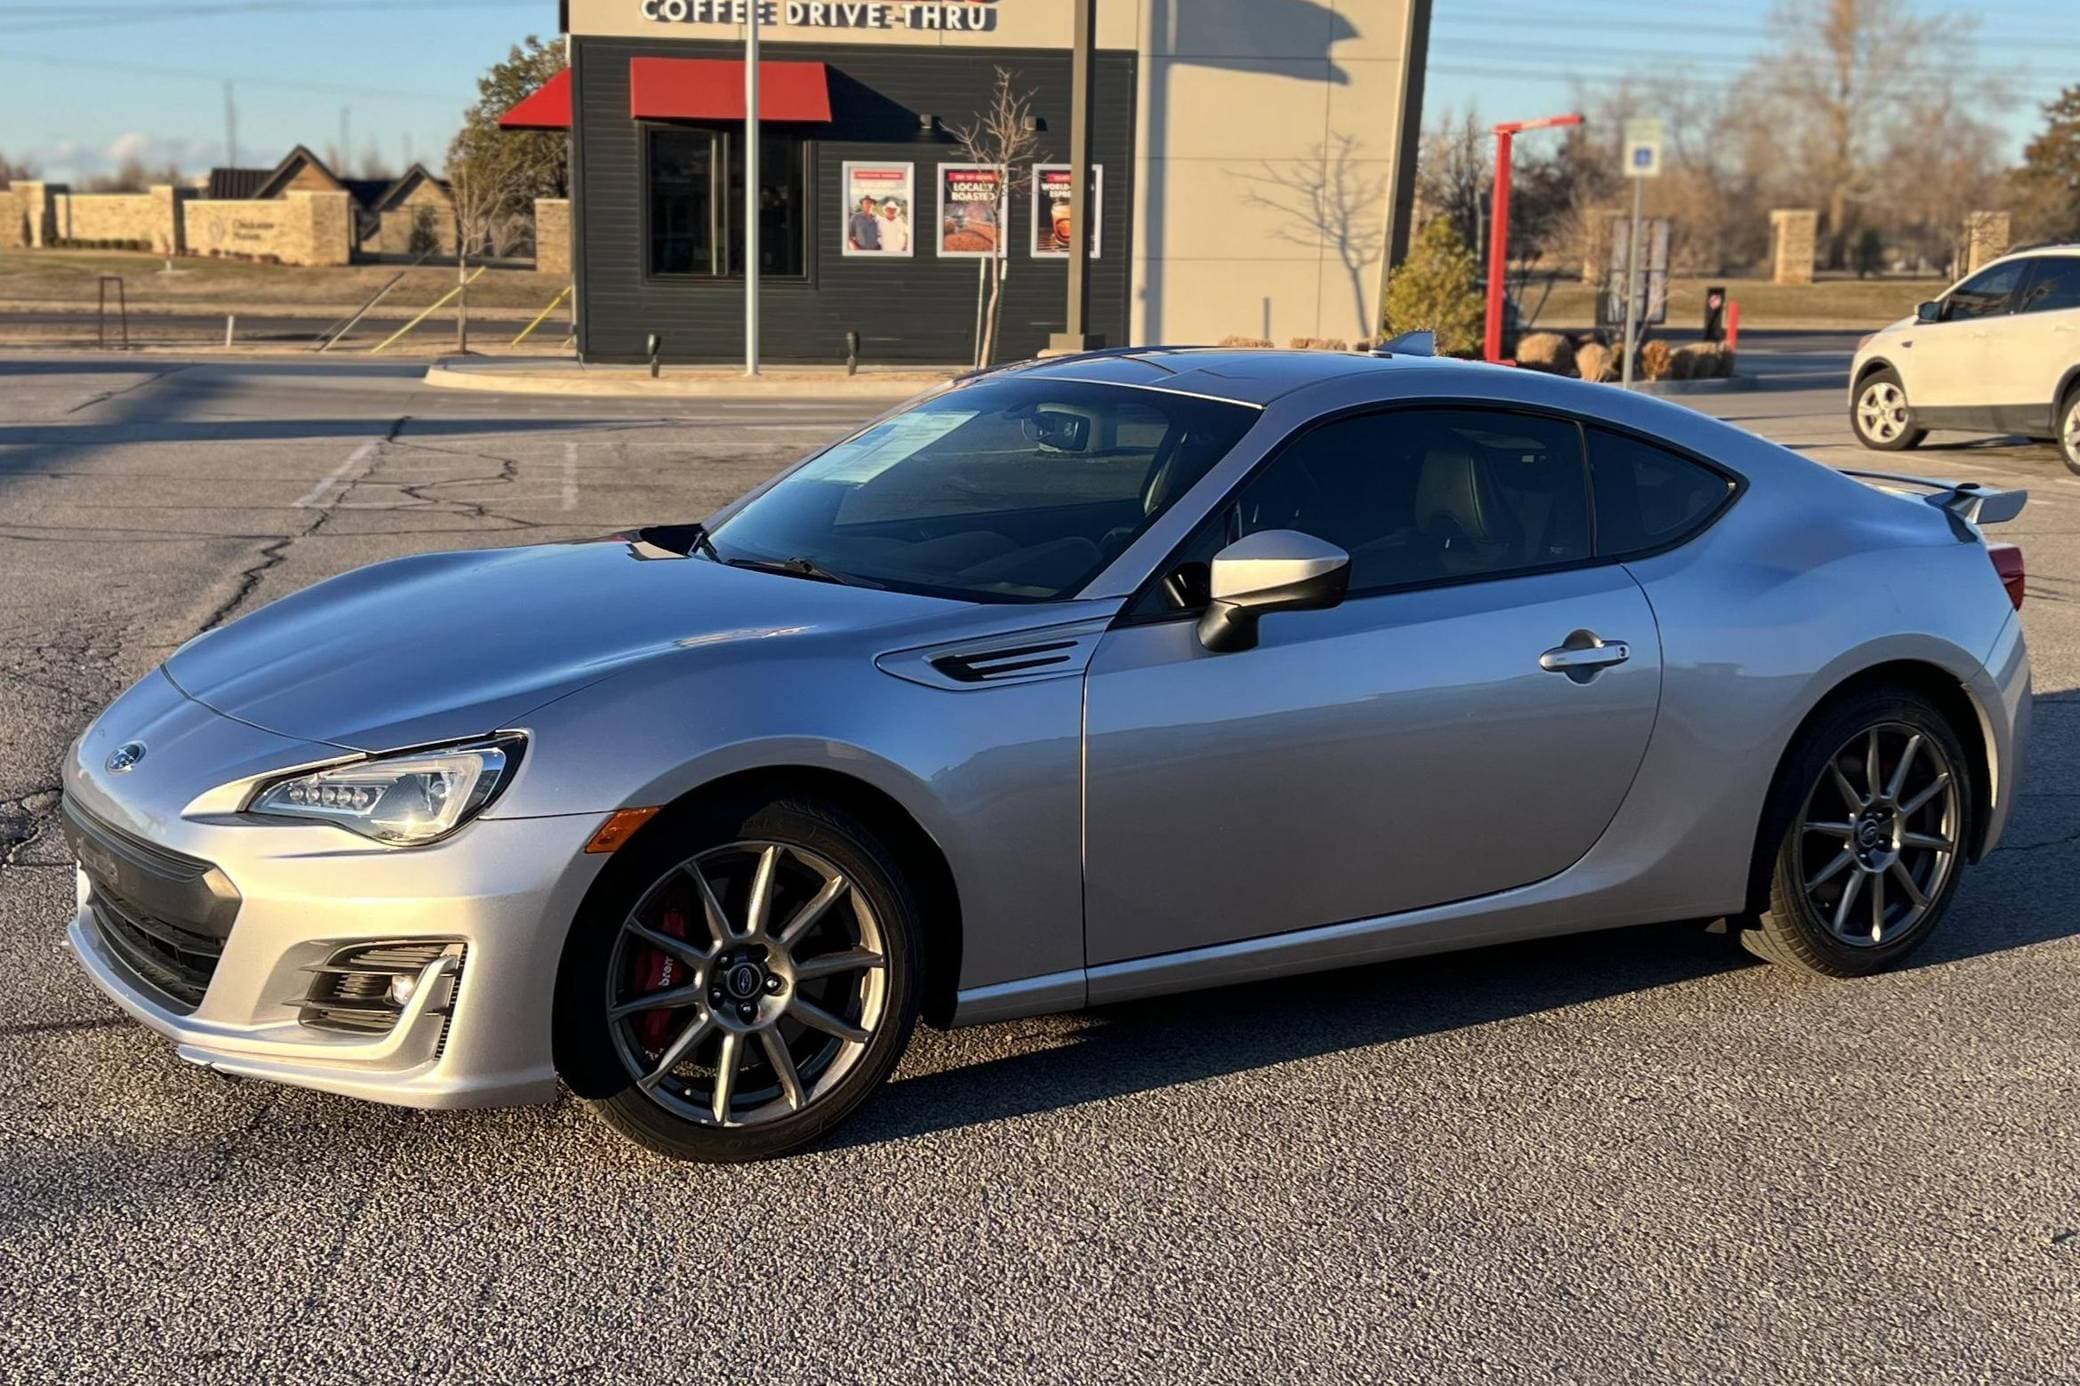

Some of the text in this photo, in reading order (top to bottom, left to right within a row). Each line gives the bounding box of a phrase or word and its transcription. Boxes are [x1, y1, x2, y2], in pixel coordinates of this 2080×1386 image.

[785, 1, 987, 30] DRIVE-THRU
[951, 191, 996, 201] ROASTED
[953, 182, 994, 191] LOCALLY
[658, 955, 674, 986] brem
